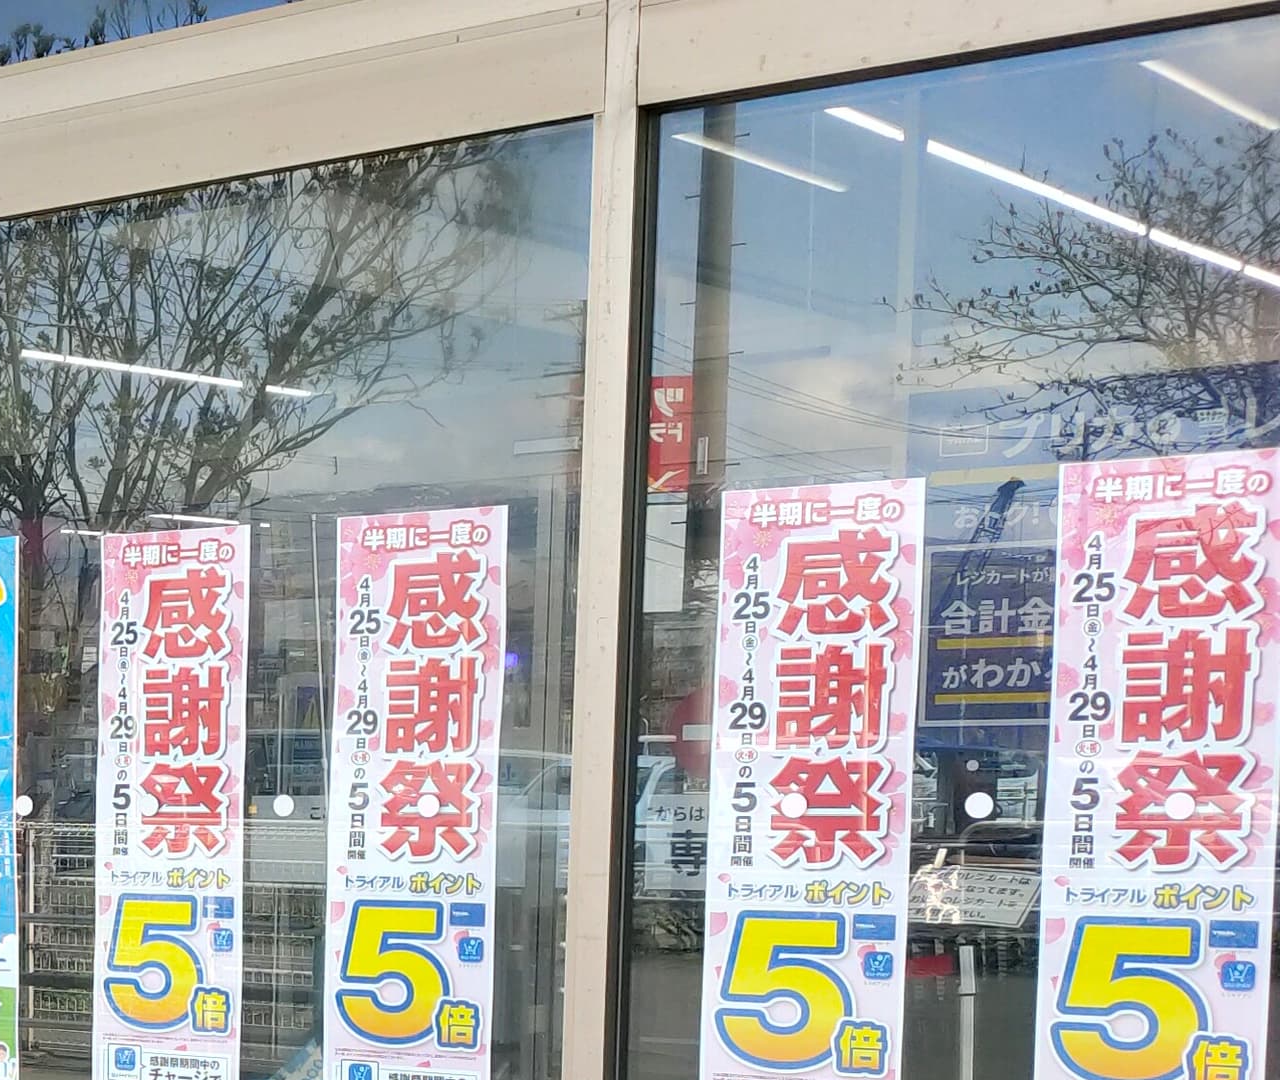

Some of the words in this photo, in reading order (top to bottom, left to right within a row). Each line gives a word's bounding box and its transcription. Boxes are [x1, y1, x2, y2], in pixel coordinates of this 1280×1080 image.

[1095, 468, 1270, 503] 半期に一度の
[752, 494, 902, 528] 半期に一度の
[363, 521, 489, 550] 半期に一度の
[124, 541, 234, 566] 半期に一度の
[942, 658, 1053, 689] がわか
[1115, 502, 1258, 867] 感謝祭
[140, 567, 227, 853] 感謝祭
[381, 551, 482, 857] 感謝祭
[770, 529, 892, 865] 感謝祭
[111, 870, 161, 885] トライアル
[166, 868, 231, 889] ポイント
[344, 874, 404, 890] トライアル
[409, 872, 482, 896] ポイント
[727, 882, 799, 900] トライアル
[804, 879, 892, 907] ポイント
[1065, 885, 1147, 904] トライアル
[1153, 883, 1256, 912] ポイント
[149, 1056, 220, 1071] 感謝祭期間中の
